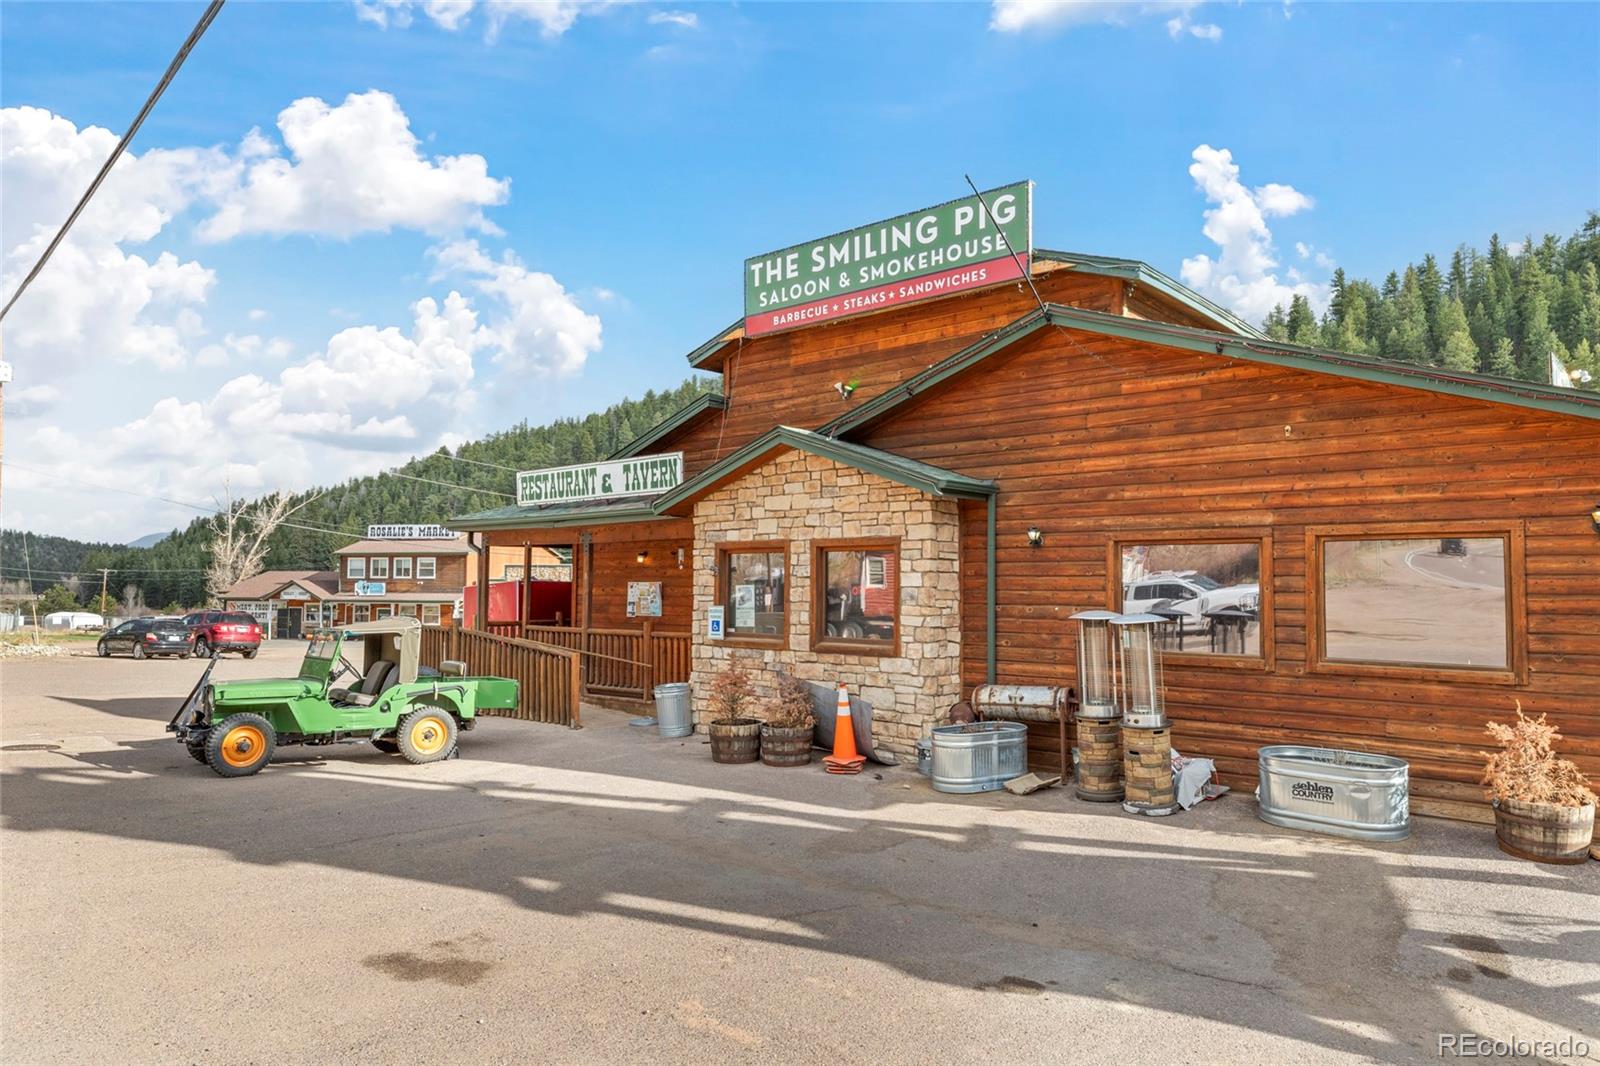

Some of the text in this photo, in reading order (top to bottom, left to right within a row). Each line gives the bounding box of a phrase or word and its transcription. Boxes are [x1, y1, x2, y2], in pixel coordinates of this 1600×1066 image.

[751, 193, 1016, 287] THE SMILING PIG
[759, 232, 1007, 307] SALOON & SMOKEHOUSE
[773, 268, 988, 325] BARBECUE STEAKS SANDWICHES
[520, 458, 678, 501] RESTAURANT & TAVERN
[370, 526, 413, 537] ROSALIE'S
[1292, 789, 1334, 801] COUNTRY
